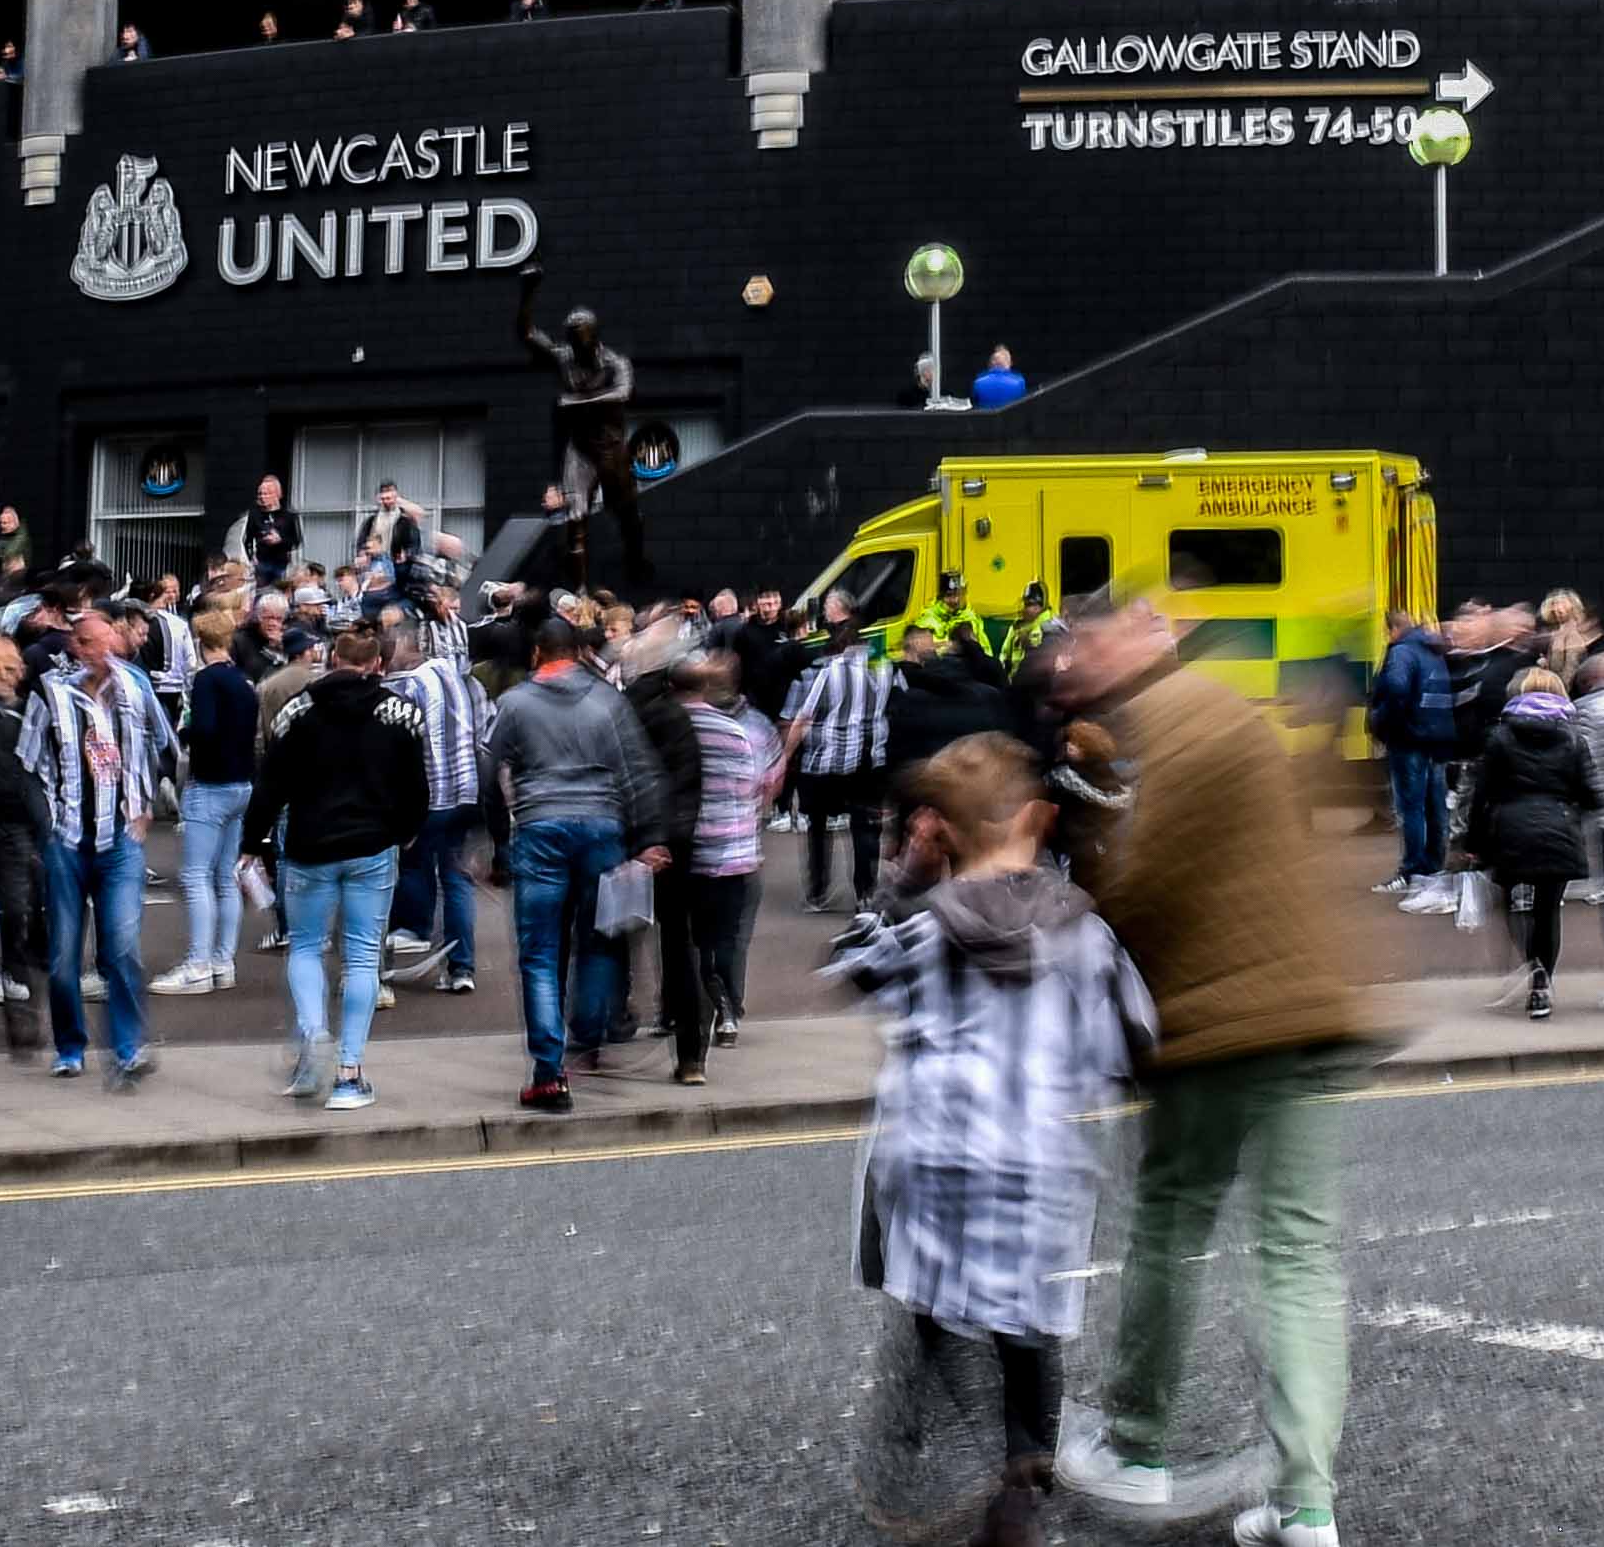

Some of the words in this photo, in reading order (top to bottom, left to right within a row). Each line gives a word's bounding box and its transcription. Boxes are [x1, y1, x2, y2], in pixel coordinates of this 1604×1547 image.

[1022, 31, 1281, 76] GALLOWGATE
[1289, 30, 1420, 69] STAND
[1022, 108, 1295, 150] TURNSTILES
[1306, 107, 1417, 146] 74-50
[226, 123, 530, 194] NEWCASTLE
[217, 198, 539, 286] UNITED
[1198, 476, 1314, 494] EMERGENCY
[1198, 498, 1317, 517] AMBULANCE
